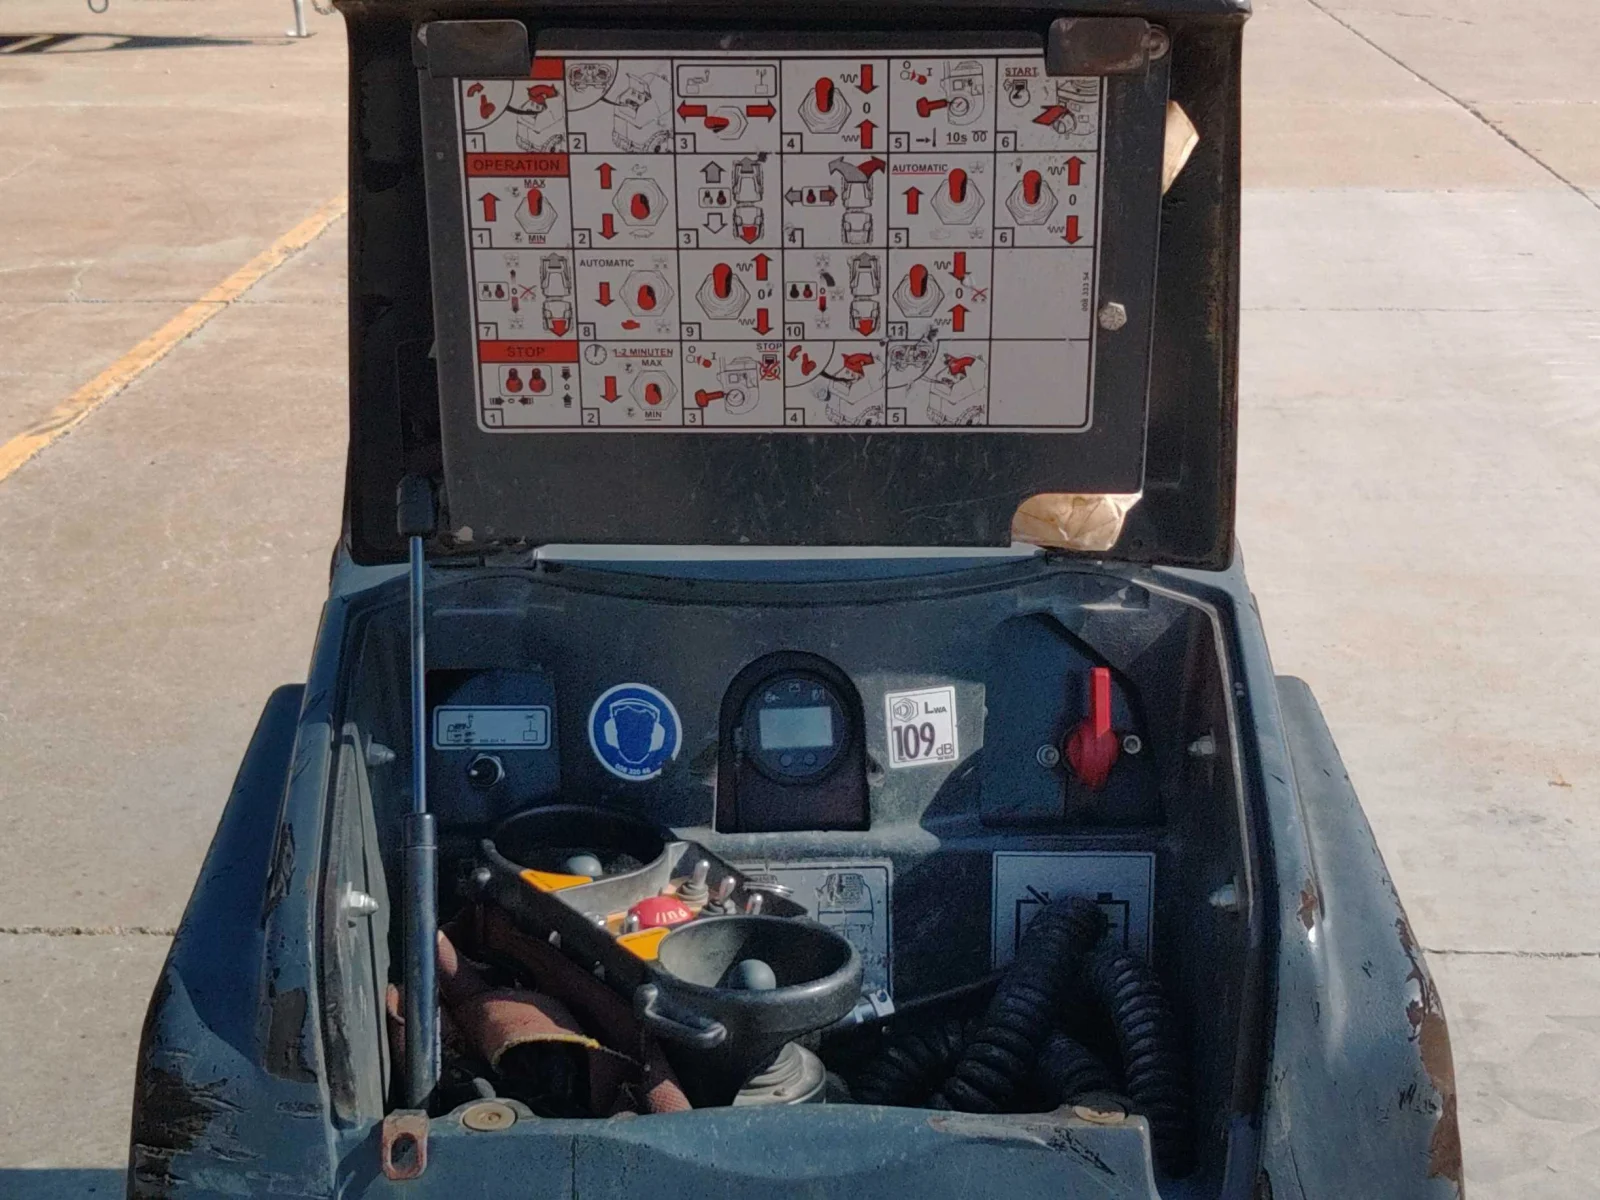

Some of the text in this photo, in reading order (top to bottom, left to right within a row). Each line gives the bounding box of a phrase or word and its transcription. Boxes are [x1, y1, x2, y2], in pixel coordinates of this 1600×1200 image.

[1004, 66, 1037, 77] START
[862, 102, 871, 114] 0
[947, 131, 967, 143] 10s
[470, 138, 478, 149] 1
[573, 138, 582, 149] 2
[679, 138, 688, 149] 3
[786, 138, 796, 149] 4
[894, 138, 903, 149] 5
[1001, 138, 1010, 149] 6
[473, 158, 560, 172] OPERATION
[891, 163, 948, 173] AUTOMATIC
[523, 178, 546, 189] MAX
[1068, 194, 1077, 206] 0
[477, 233, 485, 244] 1
[528, 234, 546, 245] MIN
[578, 233, 587, 244] 2
[683, 233, 692, 244] 3
[787, 233, 797, 244] 4
[894, 233, 903, 244] 5
[999, 233, 1008, 244] 6
[579, 258, 635, 268] AUTOMATIC
[757, 288, 766, 300] 0
[955, 287, 964, 299] 0
[483, 326, 492, 337] 7
[582, 326, 591, 337] 8
[686, 326, 694, 337] 9
[786, 326, 801, 337] 10
[507, 346, 546, 358] STOP
[756, 342, 783, 351] STOP
[629, 347, 674, 358] MINUTEN
[641, 358, 663, 368] MAX
[489, 412, 496, 424] 1
[586, 412, 595, 424] 2
[645, 410, 662, 420] MIN
[688, 412, 697, 424] 3
[790, 412, 798, 424] 4
[892, 412, 900, 424] 5
[893, 722, 936, 760] 109
[936, 743, 954, 756] dB
